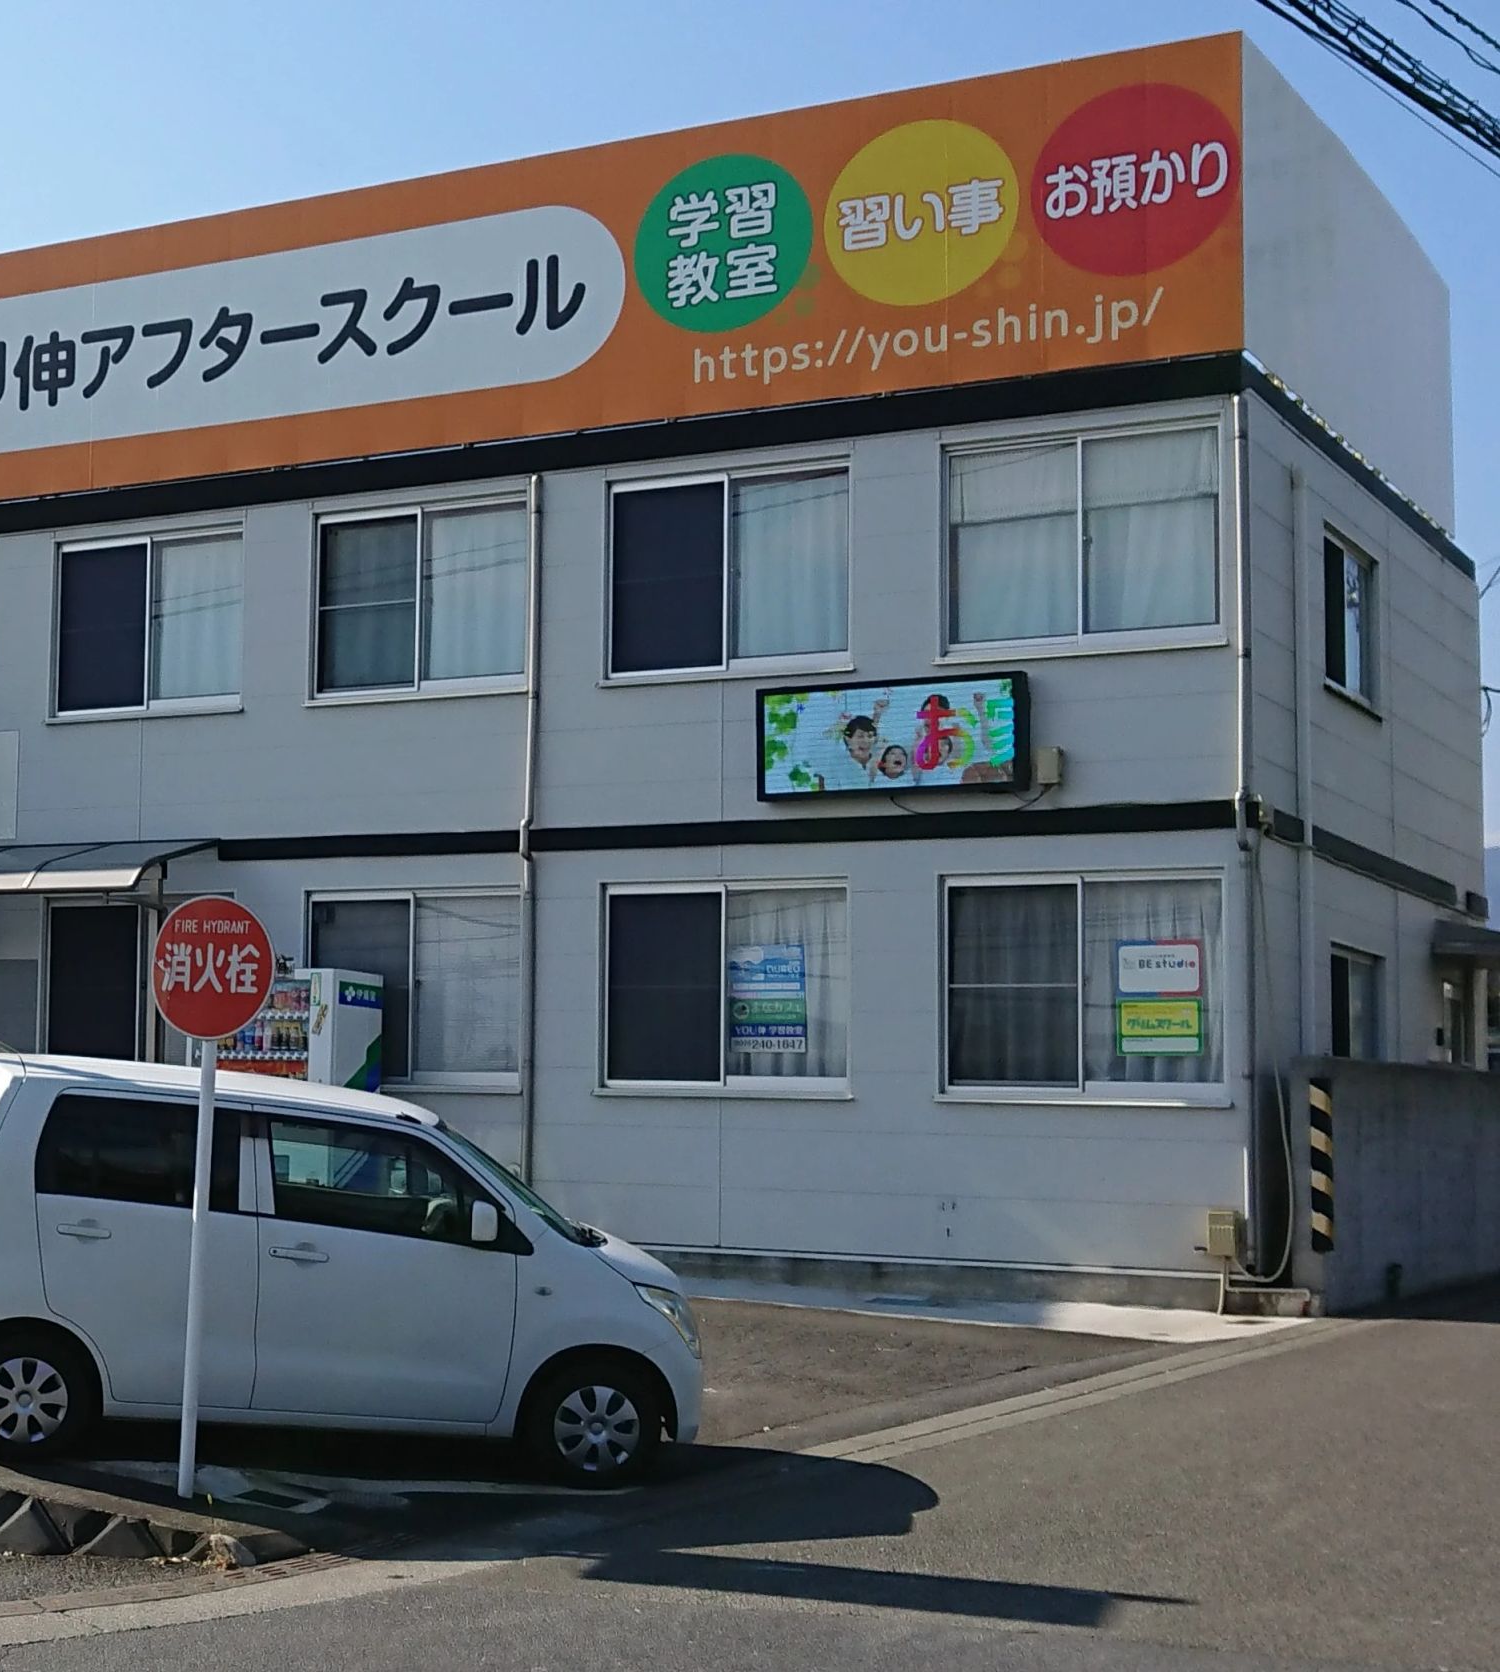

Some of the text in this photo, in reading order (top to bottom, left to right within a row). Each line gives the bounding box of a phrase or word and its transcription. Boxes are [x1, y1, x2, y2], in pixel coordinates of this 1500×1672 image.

[1044, 140, 1230, 219] お預かり
[667, 181, 777, 249] 学習
[838, 178, 1004, 252] 習い事
[667, 242, 777, 309] 教室
[693, 286, 1164, 385] https://you-shin.jp/
[174, 919, 251, 935] FIRE HYDRANT
[160, 942, 260, 994] 消火栓
[1155, 959, 1196, 969] studio
